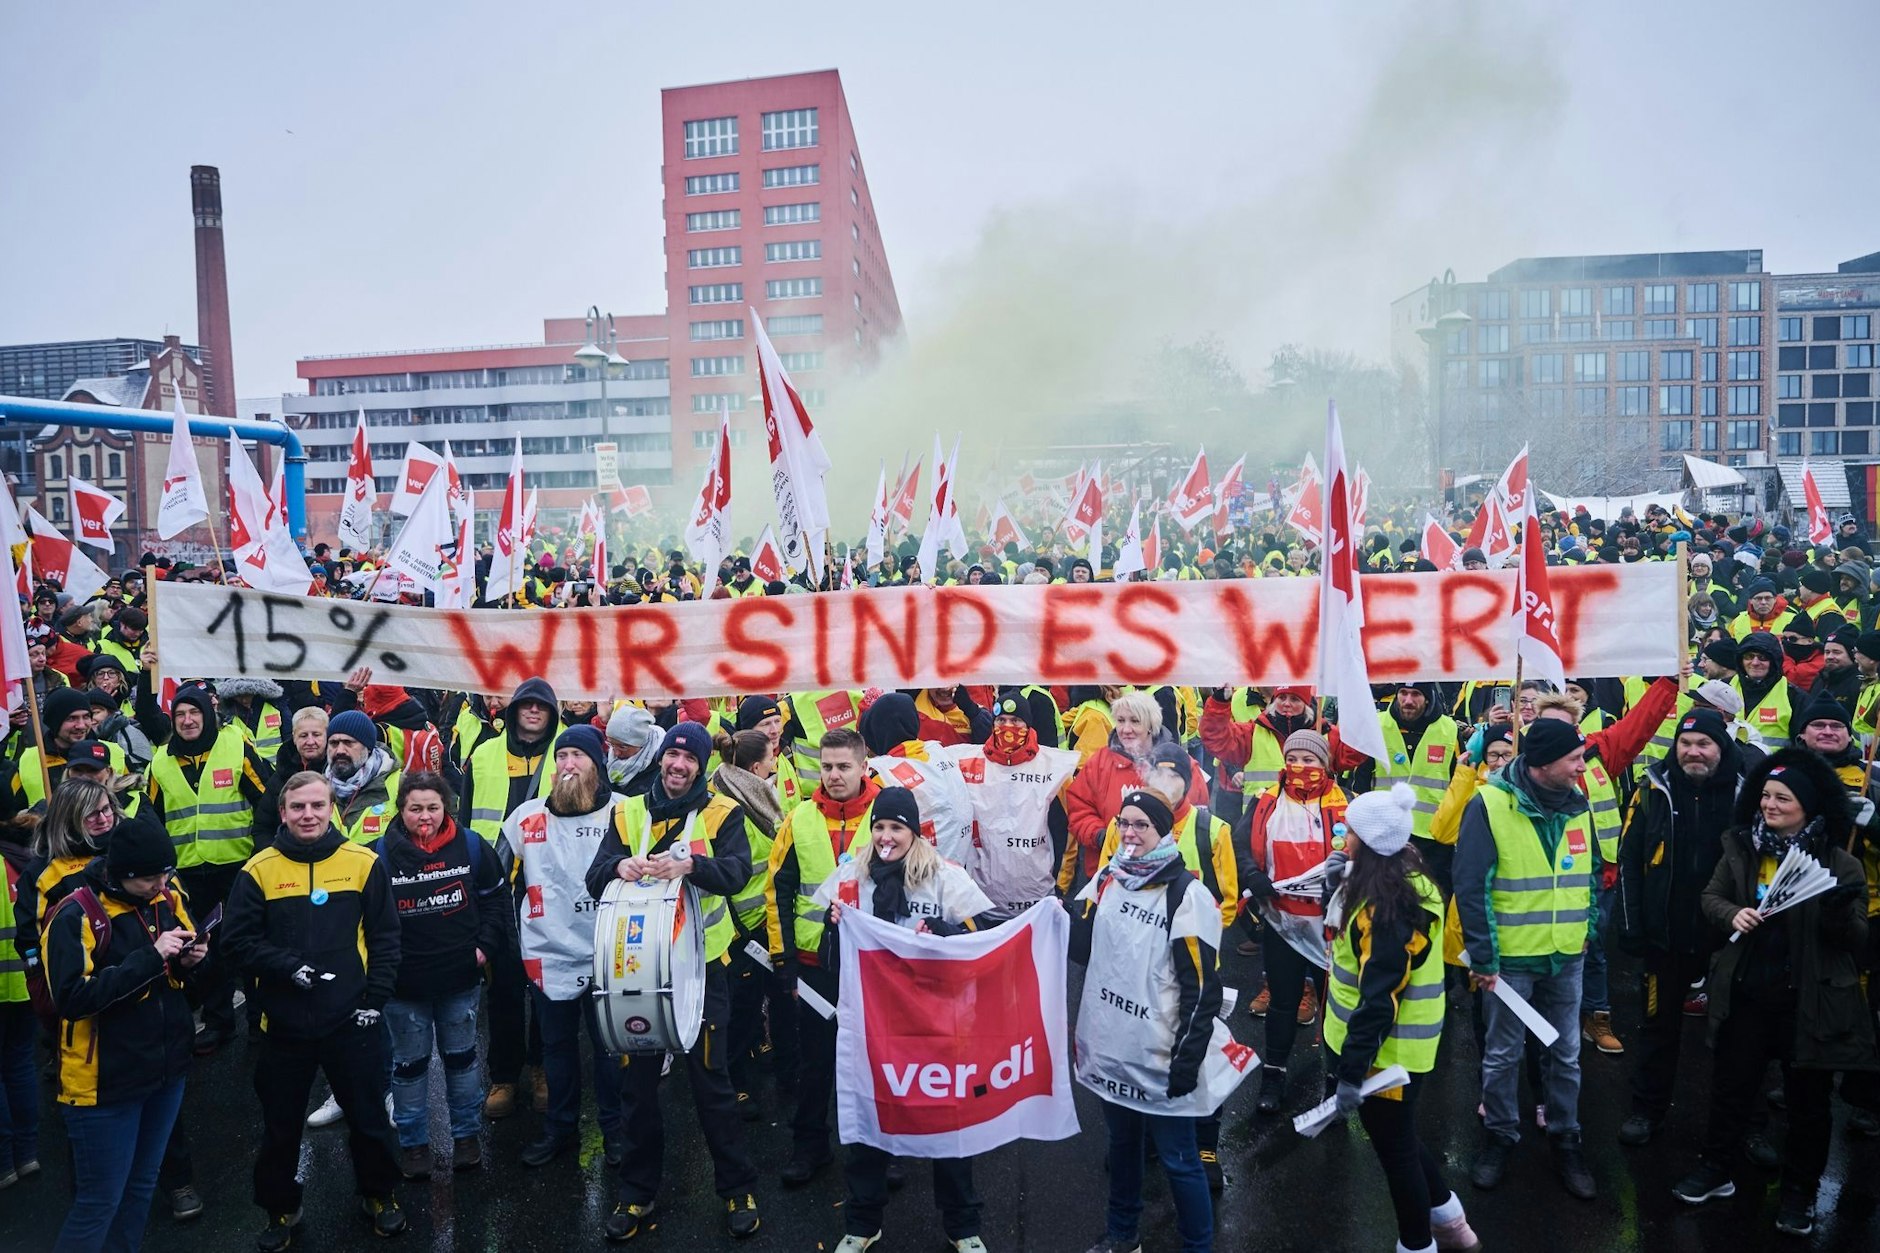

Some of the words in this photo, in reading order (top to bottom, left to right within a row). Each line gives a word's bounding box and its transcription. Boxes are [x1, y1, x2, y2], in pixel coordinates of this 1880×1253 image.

[205, 589, 409, 676] 15%
[443, 606, 688, 697] WIR
[714, 586, 1000, 695] SIND
[1037, 584, 1181, 687] ES
[1218, 568, 1621, 688] WERT
[825, 709, 853, 724] ver.di
[1010, 772, 1054, 784] STREIK
[1007, 835, 1047, 848] STREIK
[428, 888, 463, 906] ver.di
[1119, 901, 1169, 932] STREIK
[1100, 987, 1150, 1020] STREIK
[882, 1036, 1034, 1098] ver.di
[1090, 1073, 1148, 1101] STREIK
